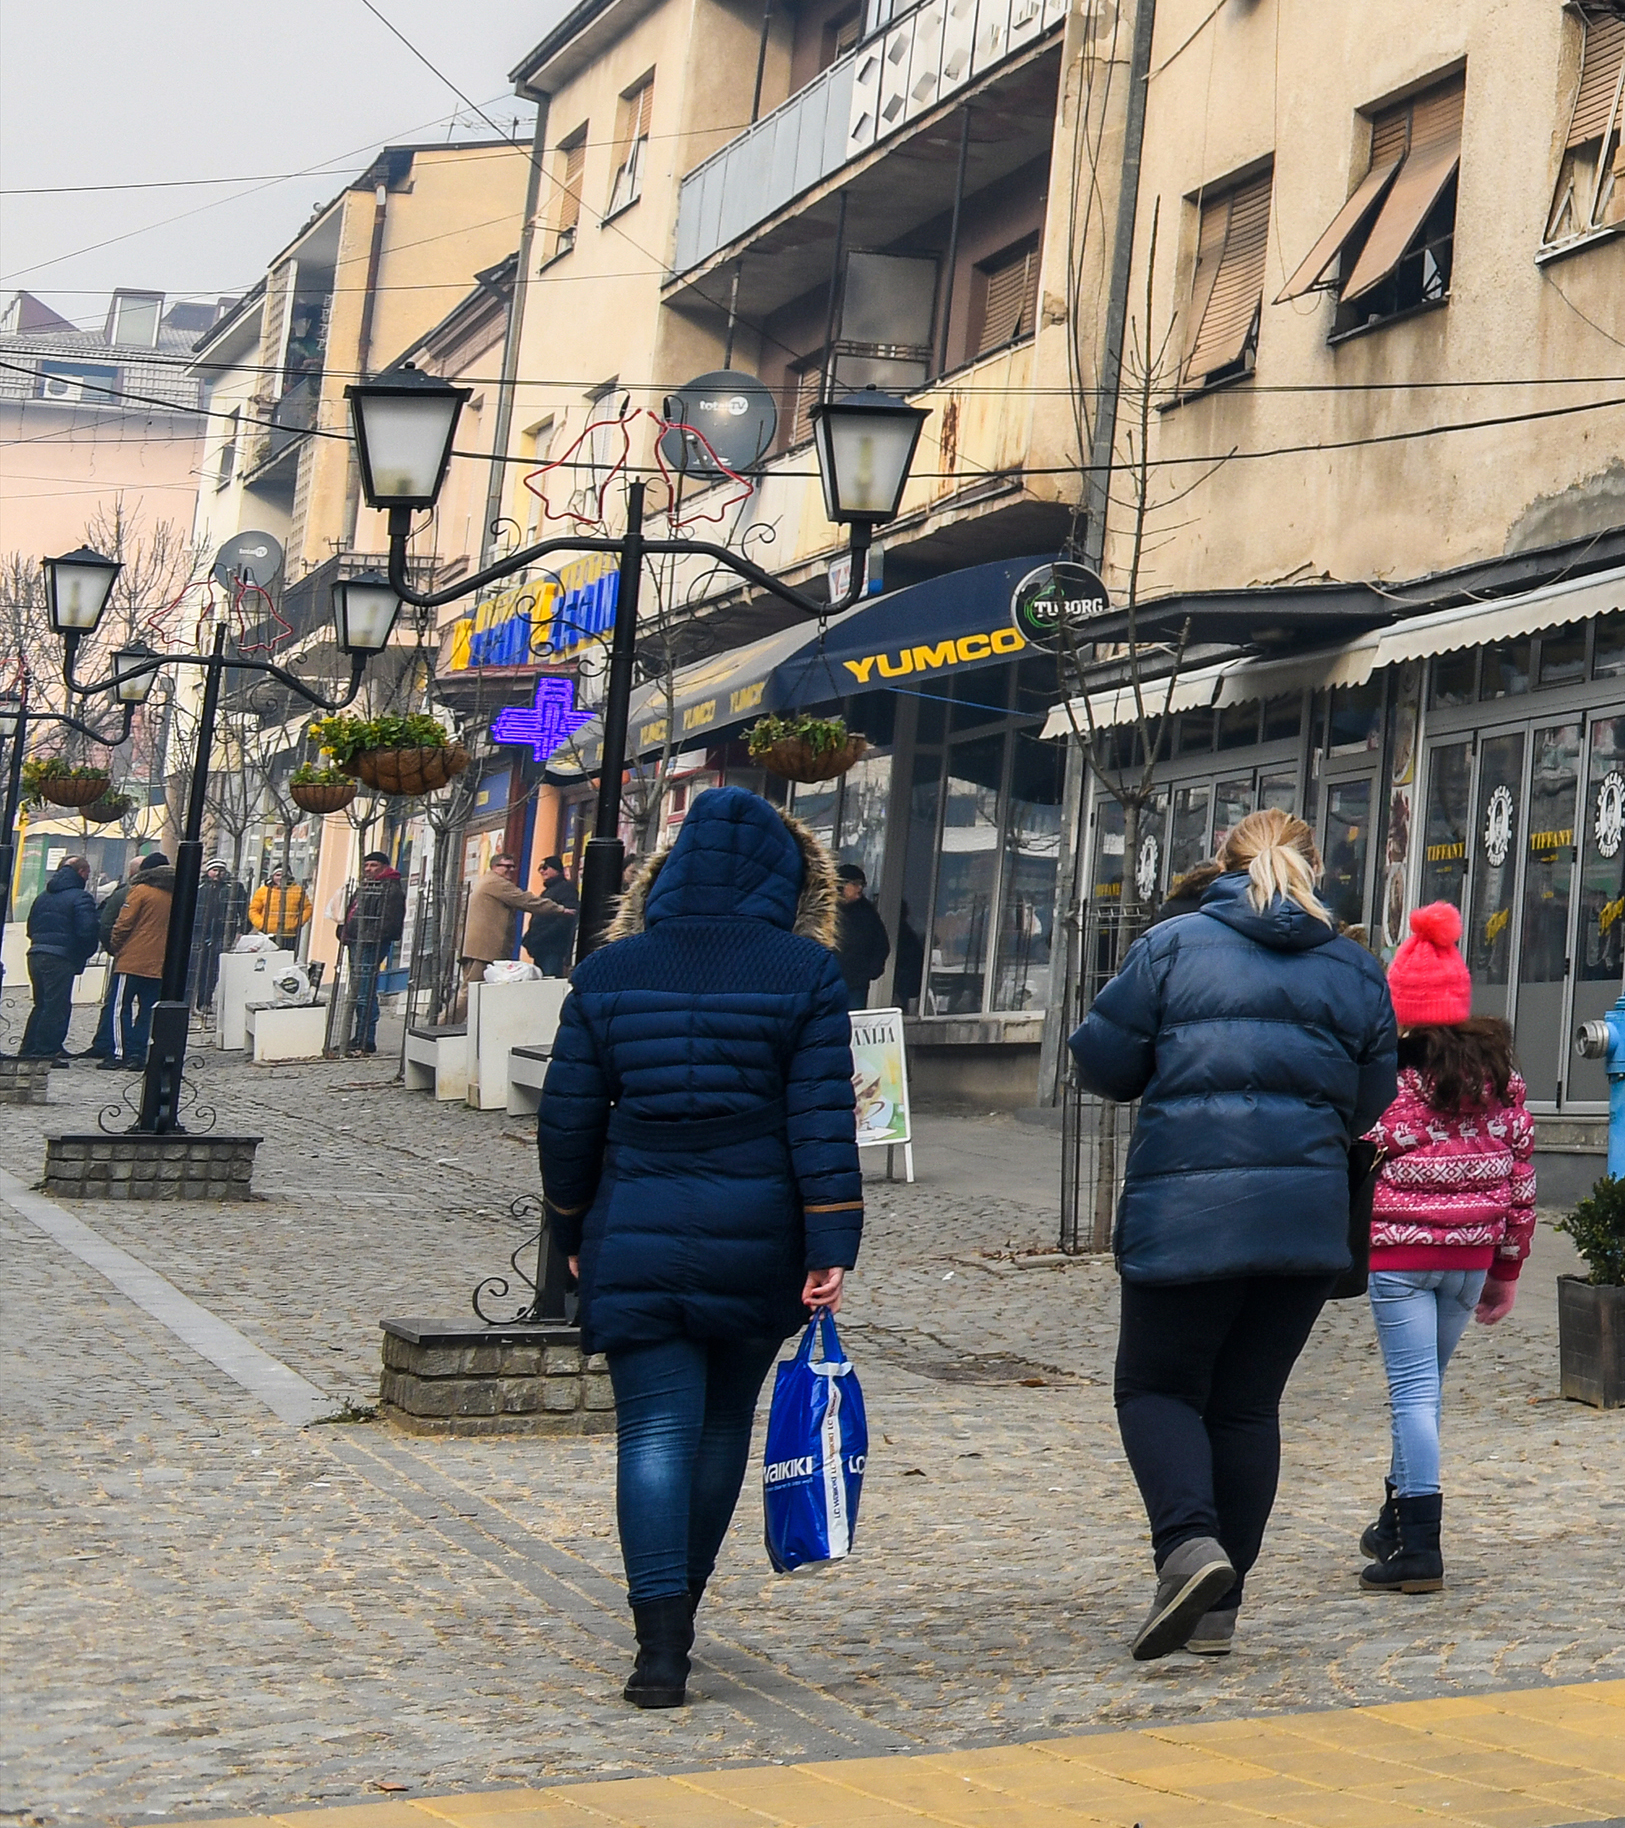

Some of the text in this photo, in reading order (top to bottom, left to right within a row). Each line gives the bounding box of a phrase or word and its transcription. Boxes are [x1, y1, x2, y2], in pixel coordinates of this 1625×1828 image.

[843, 626, 1026, 684] YUMCO
[1531, 829, 1573, 850] TIFFANY
[1427, 843, 1465, 861] TIFFANY
